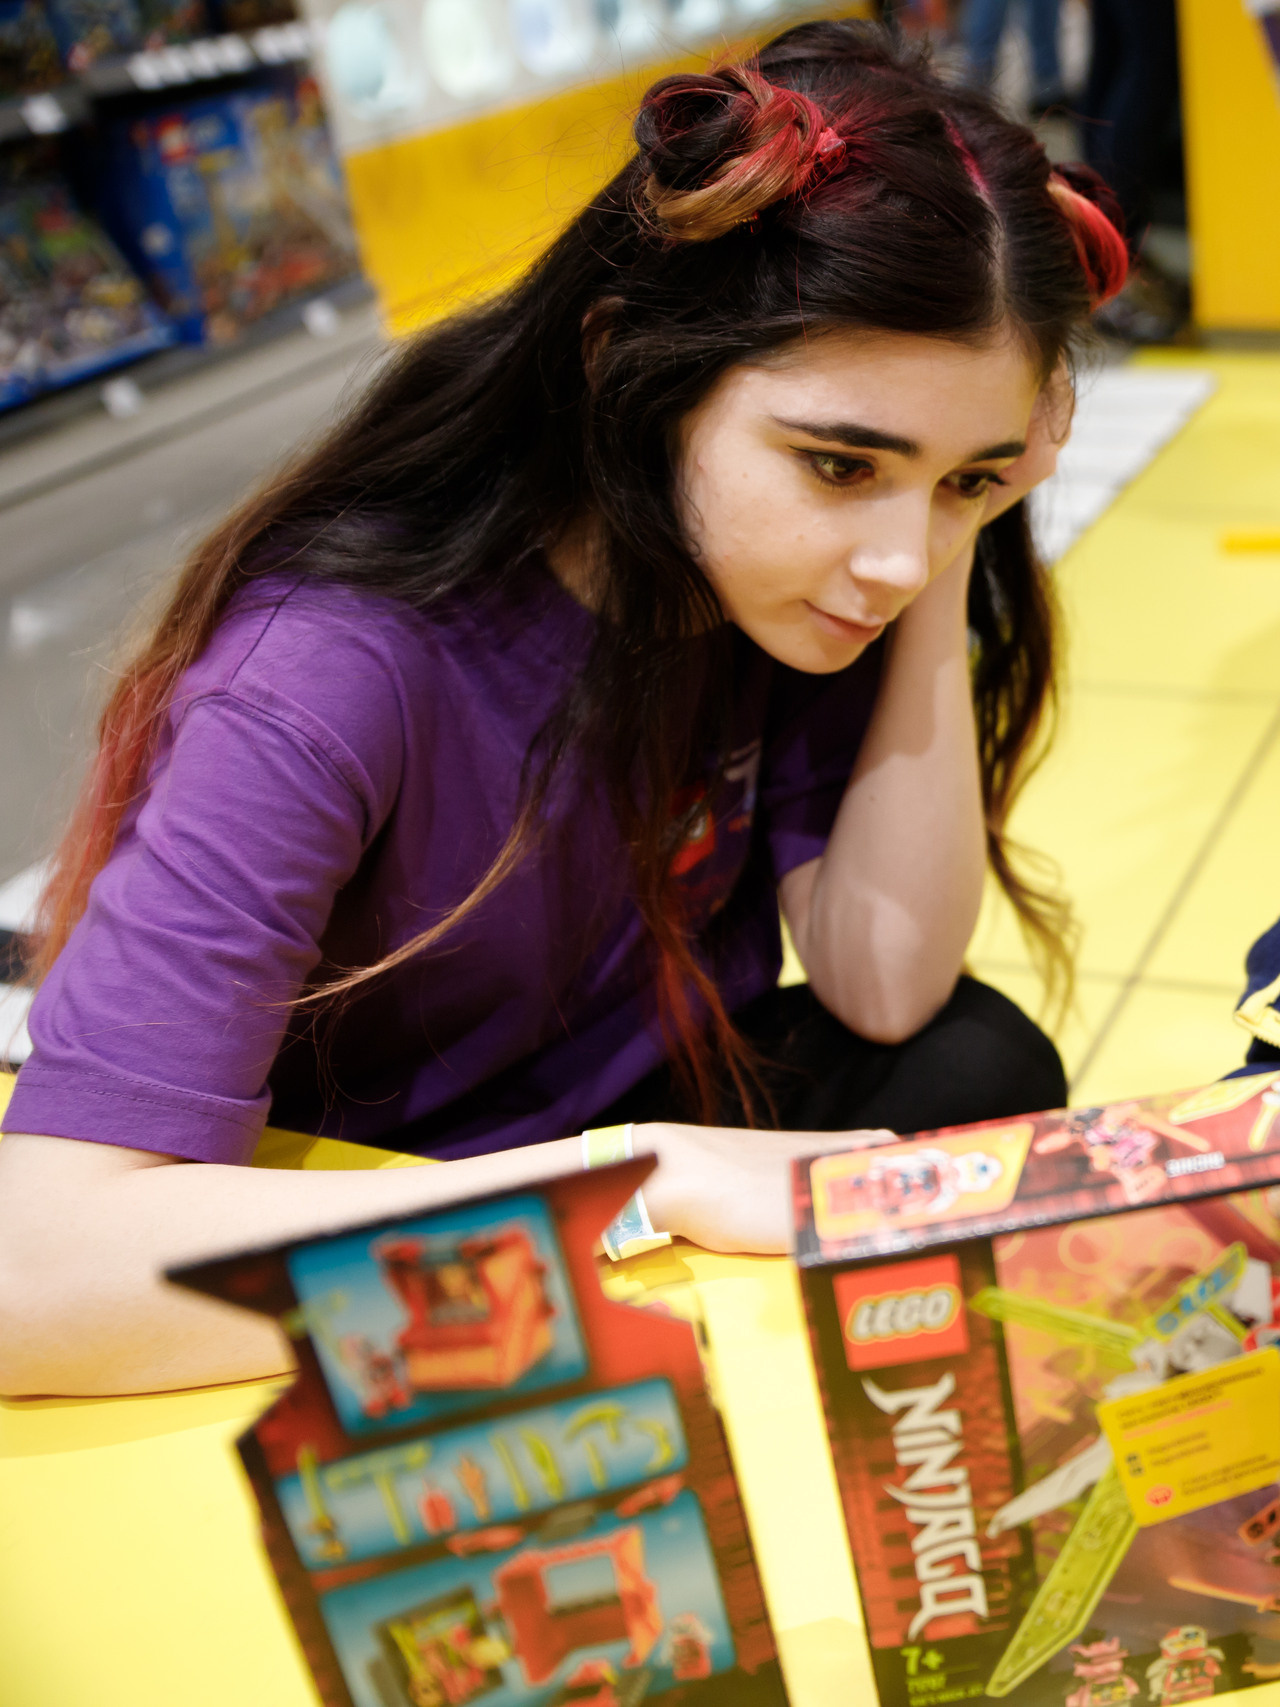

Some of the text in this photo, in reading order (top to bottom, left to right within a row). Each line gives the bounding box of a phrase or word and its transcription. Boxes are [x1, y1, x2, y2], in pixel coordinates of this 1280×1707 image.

[850, 1286, 956, 1342] LEGO
[861, 1372, 989, 1641] NINJAGO
[900, 1646, 945, 1676] 7+
